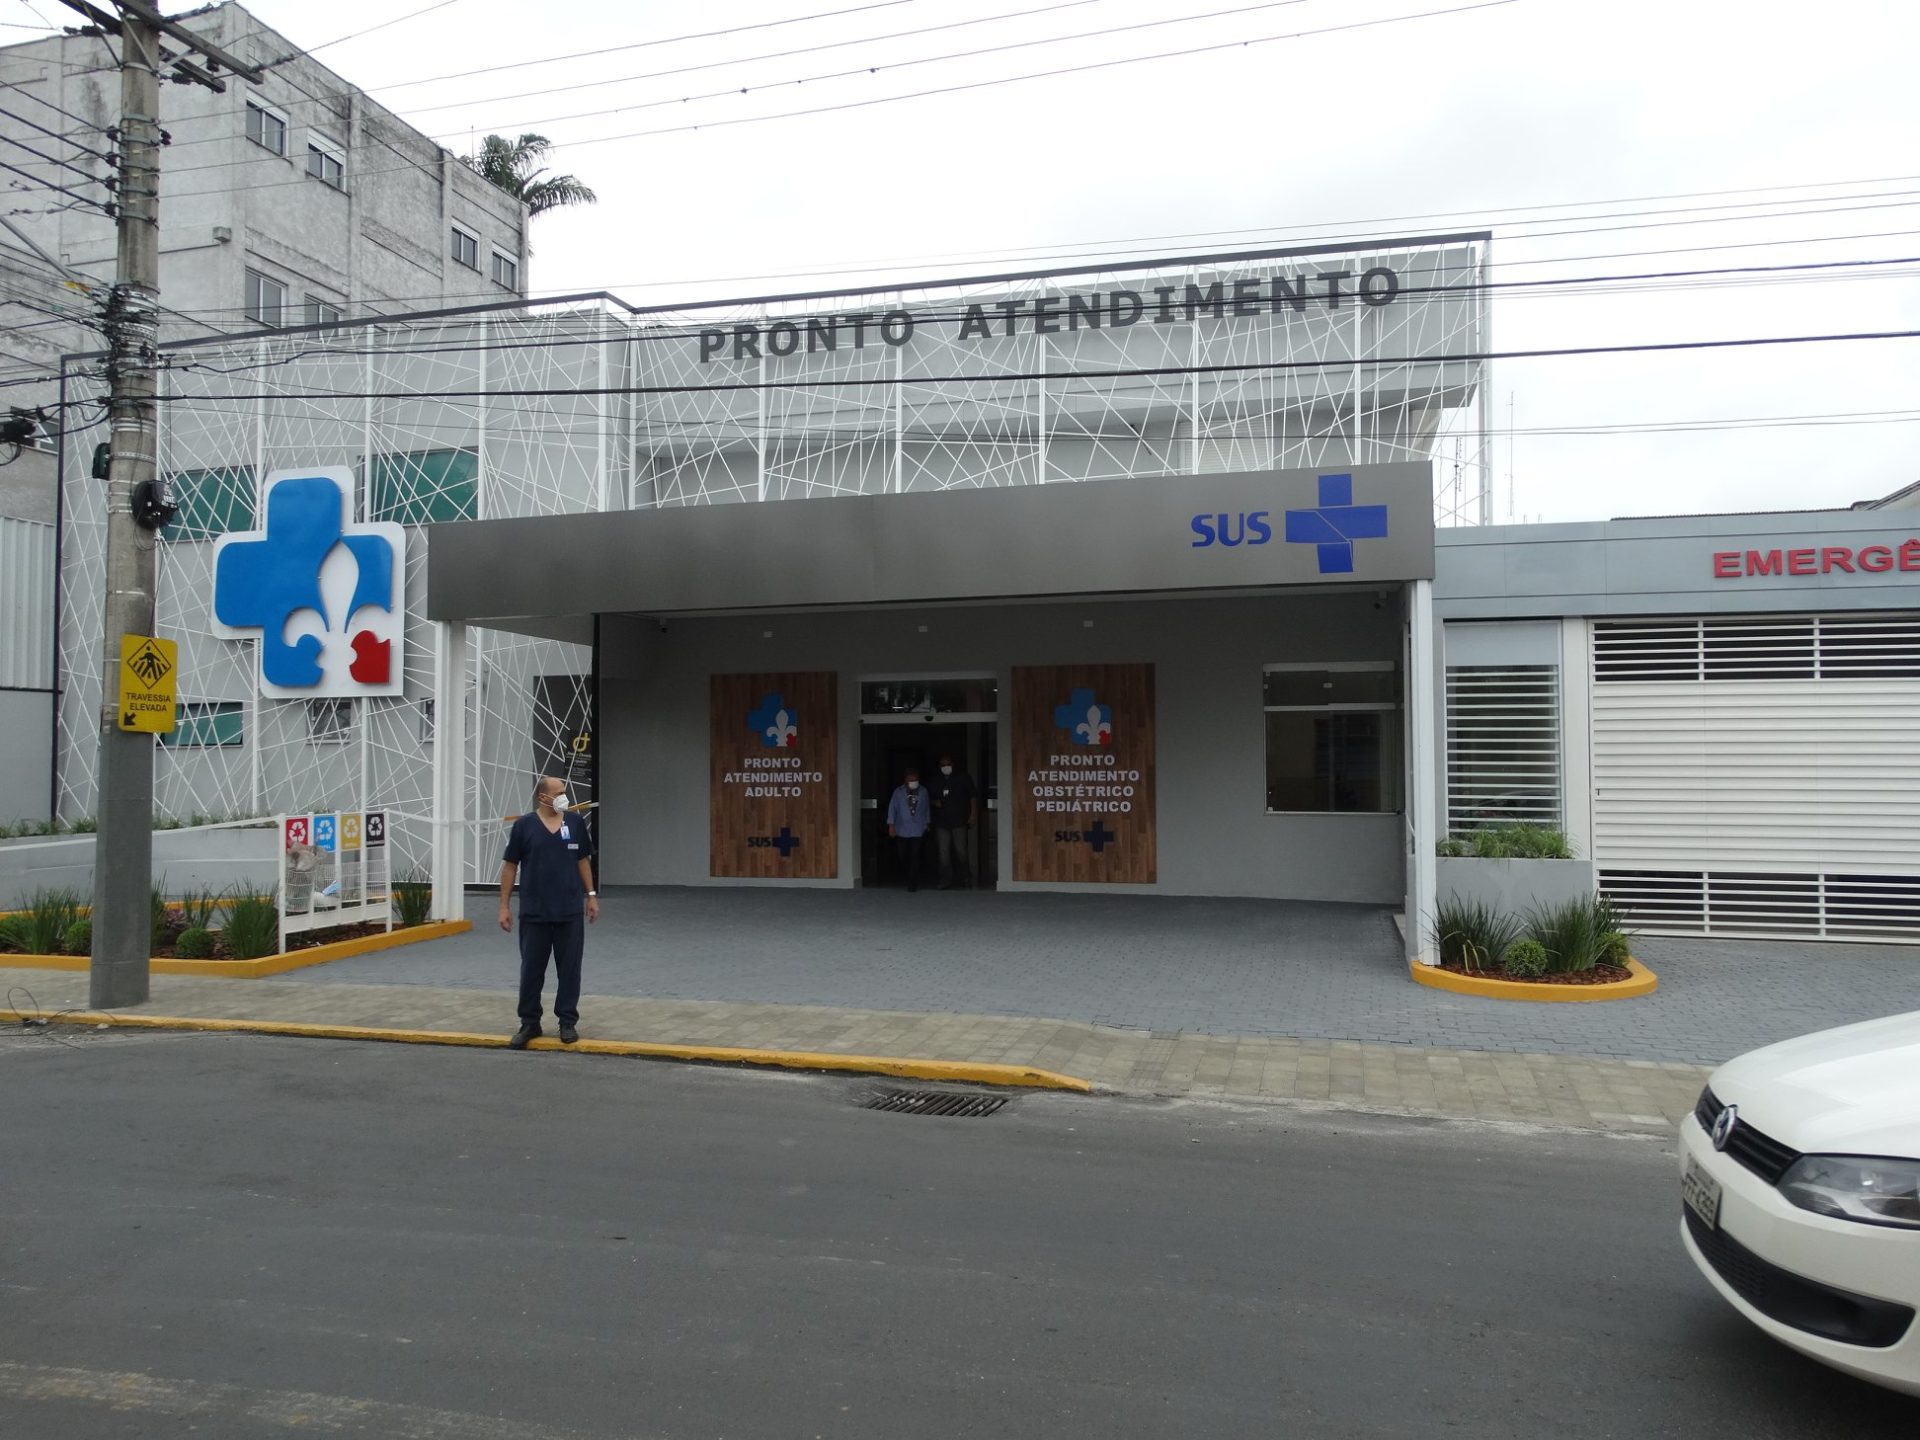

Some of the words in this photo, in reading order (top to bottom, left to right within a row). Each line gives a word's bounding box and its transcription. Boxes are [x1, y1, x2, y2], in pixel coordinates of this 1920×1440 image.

[700, 309, 914, 363] PRONTO
[957, 266, 1399, 341] ATENDIMENTO
[1190, 511, 1272, 548] SUS
[1713, 539, 1920, 578] EMERGÊ
[126, 692, 171, 703] TRAVESSIA
[129, 702, 168, 712] ELEVADA
[743, 757, 802, 769] PRONTO
[1050, 754, 1116, 766] PRONTO
[723, 771, 823, 784] ATENDIMENTO
[1028, 769, 1140, 782] ATENDIMENTO
[744, 786, 802, 797] ADULTO
[1032, 783, 1135, 797] OBSTÉTRICO
[1036, 798, 1133, 813] PEDIÁTRICO
[747, 836, 771, 848] SUS
[1055, 831, 1081, 842] SUS
